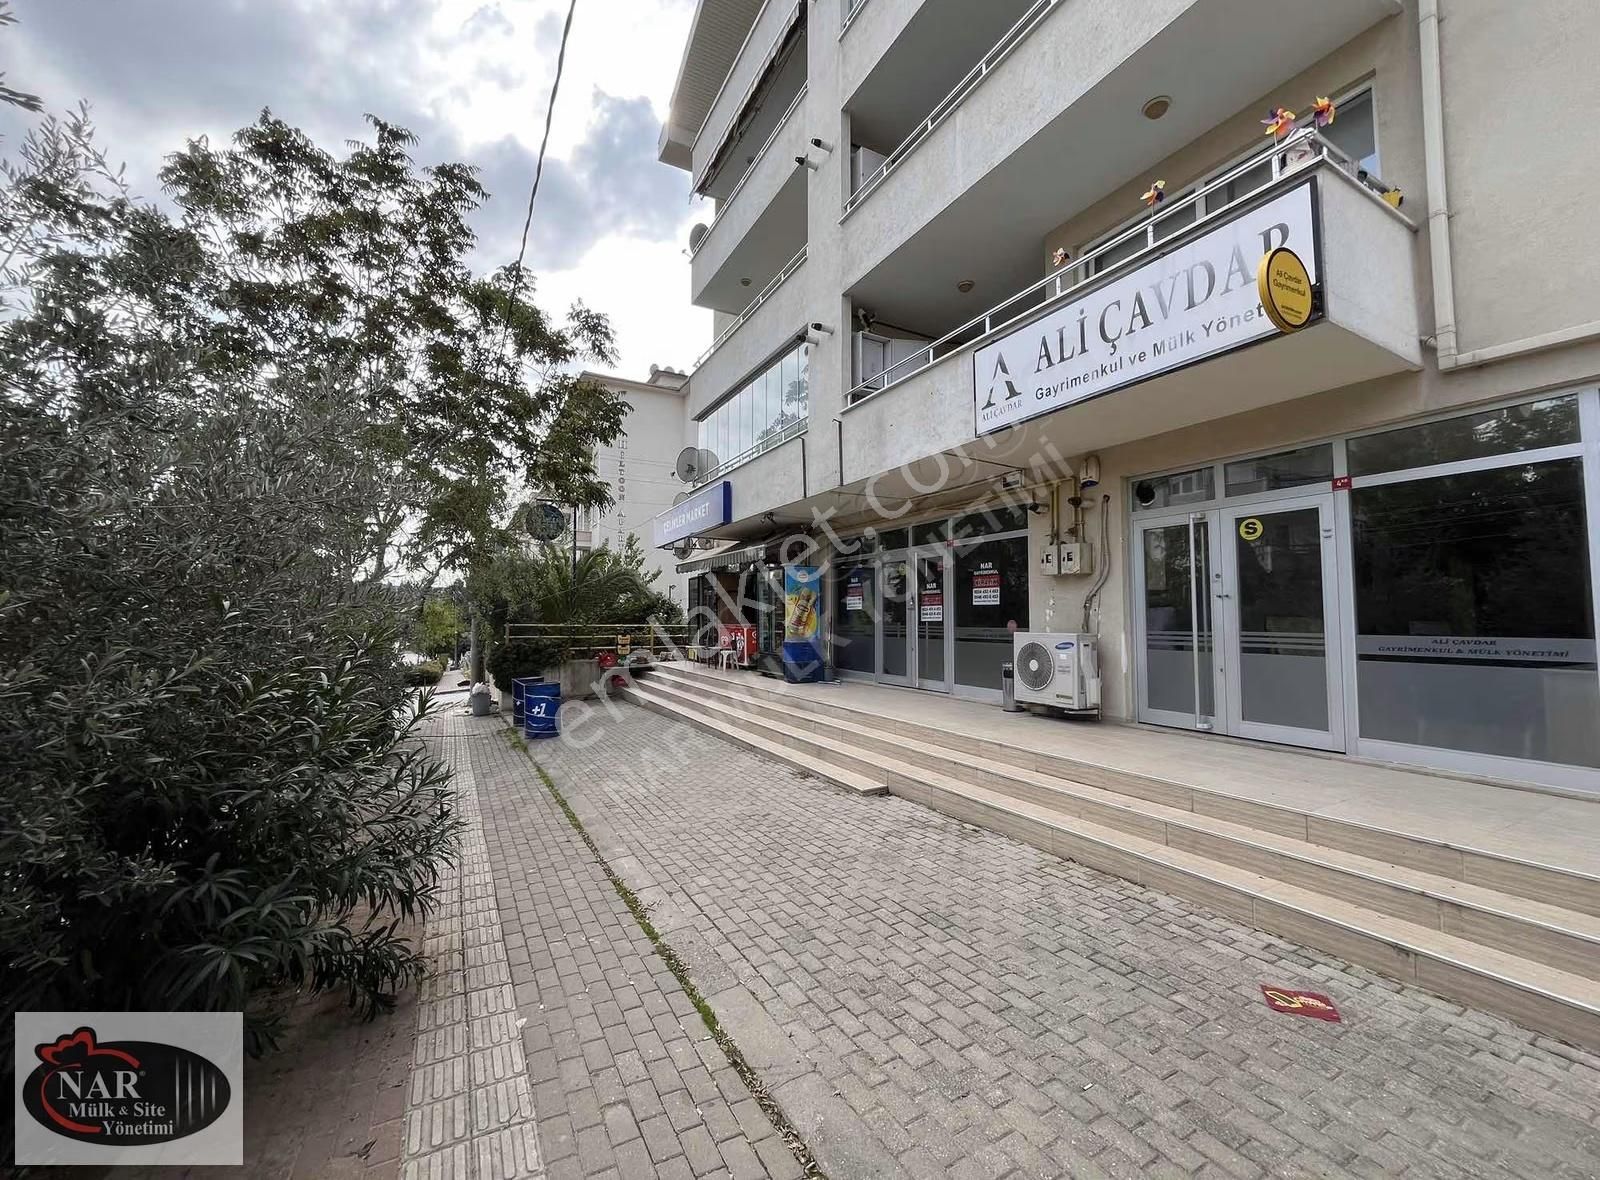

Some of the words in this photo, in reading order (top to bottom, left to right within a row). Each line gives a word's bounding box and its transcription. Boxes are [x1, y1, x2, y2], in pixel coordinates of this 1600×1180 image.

[1034, 308, 1089, 374] ALİ
[1035, 356, 1124, 401] Gayrimenkul
[1128, 348, 1147, 367] ve
[1153, 329, 1196, 358] Mülk
[1202, 303, 1264, 338] Yönet
[1244, 521, 1258, 535] S
[531, 703, 547, 717] +1
